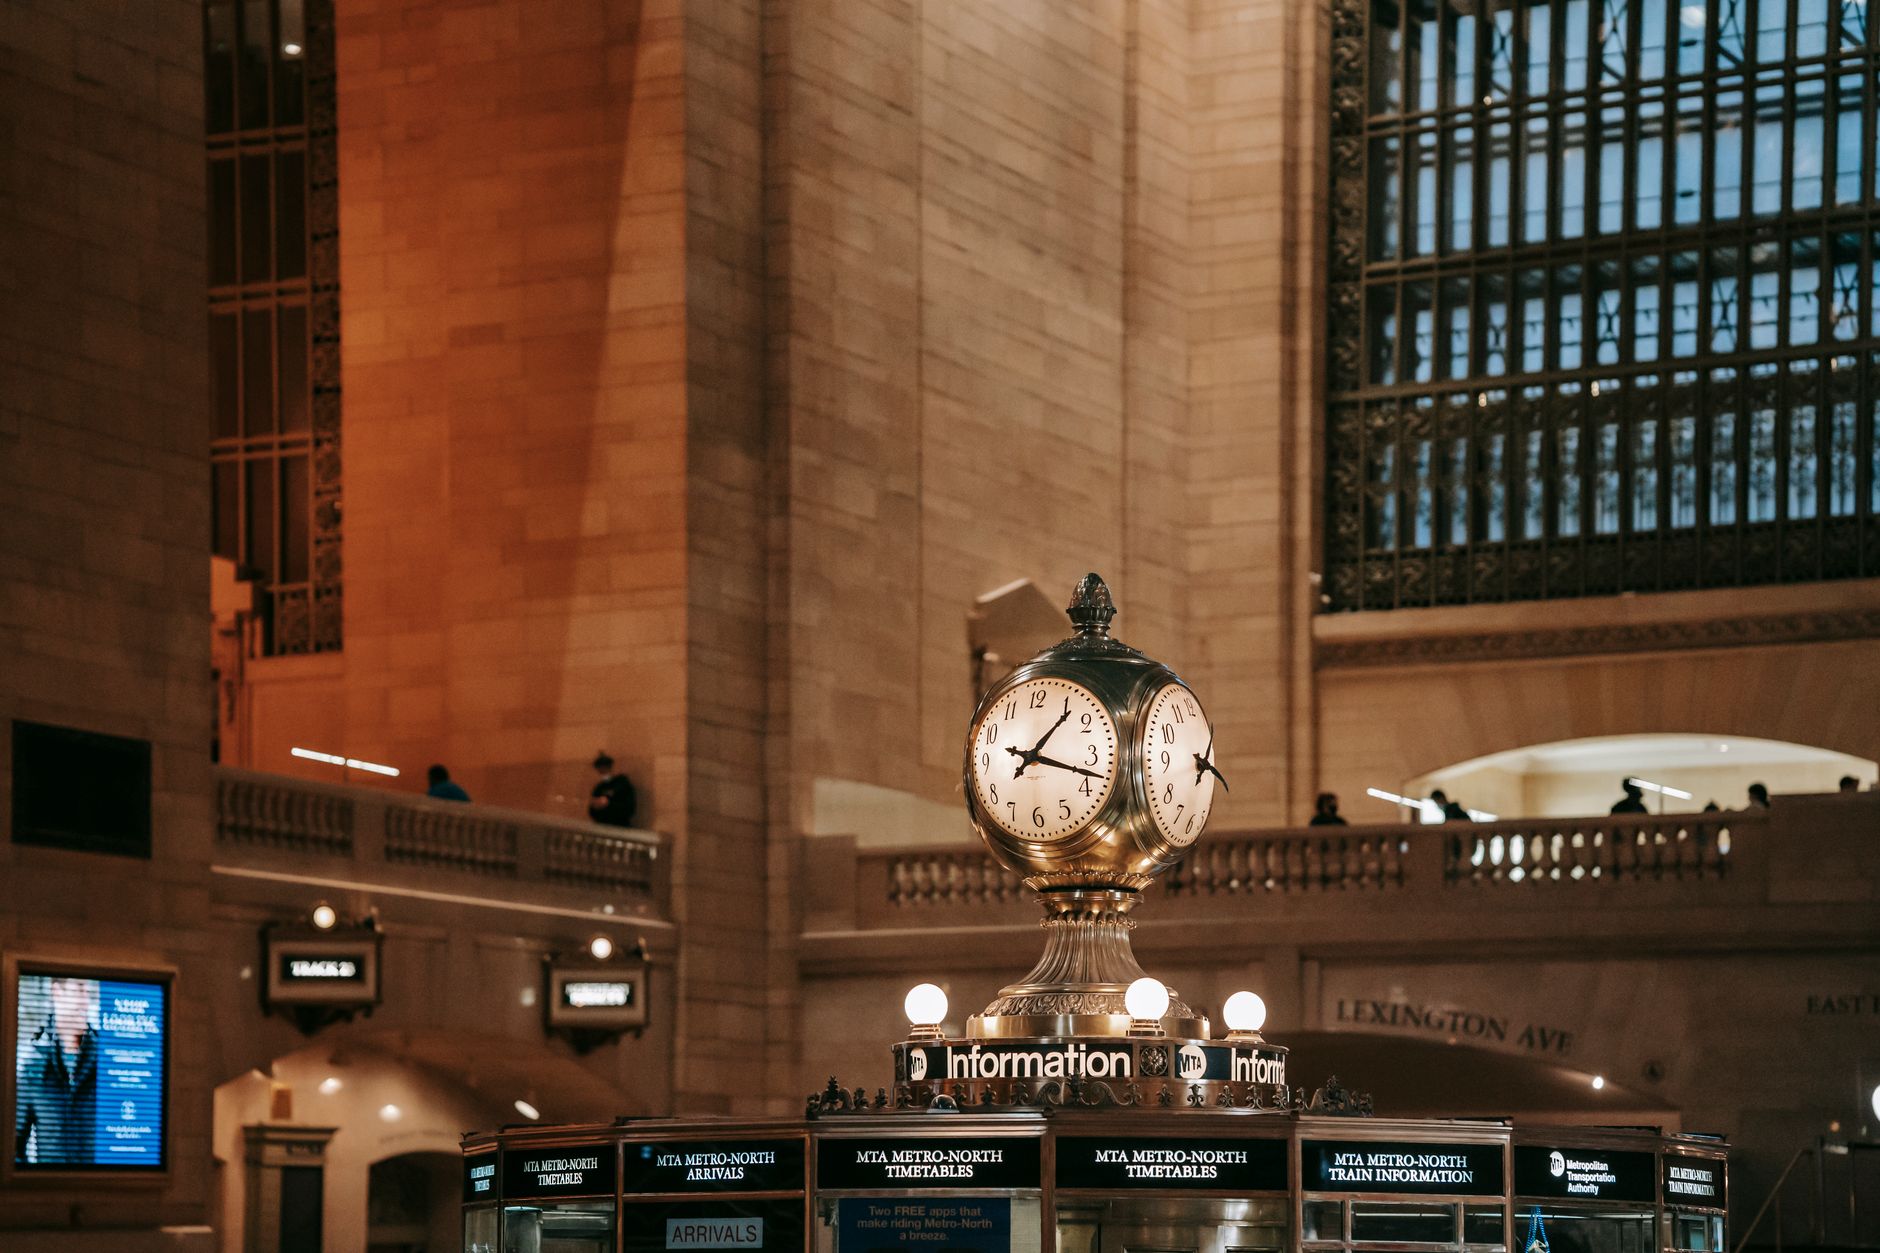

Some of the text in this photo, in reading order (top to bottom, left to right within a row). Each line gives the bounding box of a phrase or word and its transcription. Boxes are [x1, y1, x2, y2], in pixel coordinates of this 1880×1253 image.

[1030, 690, 1047, 709] 12
[1063, 695, 1070, 713] 1
[1004, 700, 1017, 720] 11
[1171, 704, 1184, 724] 11
[1080, 713, 1092, 734] 2
[986, 723, 998, 744] 10
[1162, 723, 1174, 744] 10
[982, 752, 990, 775] 9
[1084, 744, 1098, 766] 3
[1160, 750, 1170, 774] 9
[989, 783, 998, 804] 8
[1078, 775, 1093, 797] 4
[1163, 783, 1174, 804] 8
[1006, 801, 1017, 822] 7
[1032, 806, 1045, 828] 6
[1058, 799, 1071, 820] 5
[1173, 804, 1184, 824] 7
[1185, 814, 1196, 834] 6
[1336, 999, 1573, 1053] LEXINGTON AVE
[946, 1043, 1131, 1080] Information
[524, 1158, 598, 1172] MTA METRO-NORTH
[656, 1152, 775, 1166] MTA METRO-NORTH
[856, 1150, 1003, 1163] MTA METRO-NORTH
[1095, 1150, 1248, 1164] MTA METRO-NORTH
[1334, 1153, 1468, 1168] MTA METRO-NORTH
[686, 1167, 744, 1180] ARRIVALS
[885, 1165, 974, 1178] TIMETABLES
[1126, 1165, 1218, 1178] TIMETABLES
[1566, 1160, 1609, 1172] Metropolitan
[1670, 1166, 1680, 1178] MTA
[538, 1172, 582, 1186] TIMETABLES
[1328, 1168, 1474, 1183] TRAIN INFORMATION
[1567, 1172, 1616, 1184] Transportation
[1568, 1184, 1599, 1196] Authority
[869, 1206, 982, 1219] Two FREE apps that
[672, 1225, 757, 1243] ARRIVALS
[857, 1218, 993, 1232] make riding Metro-North
[900, 1230, 950, 1240] a breeze.
